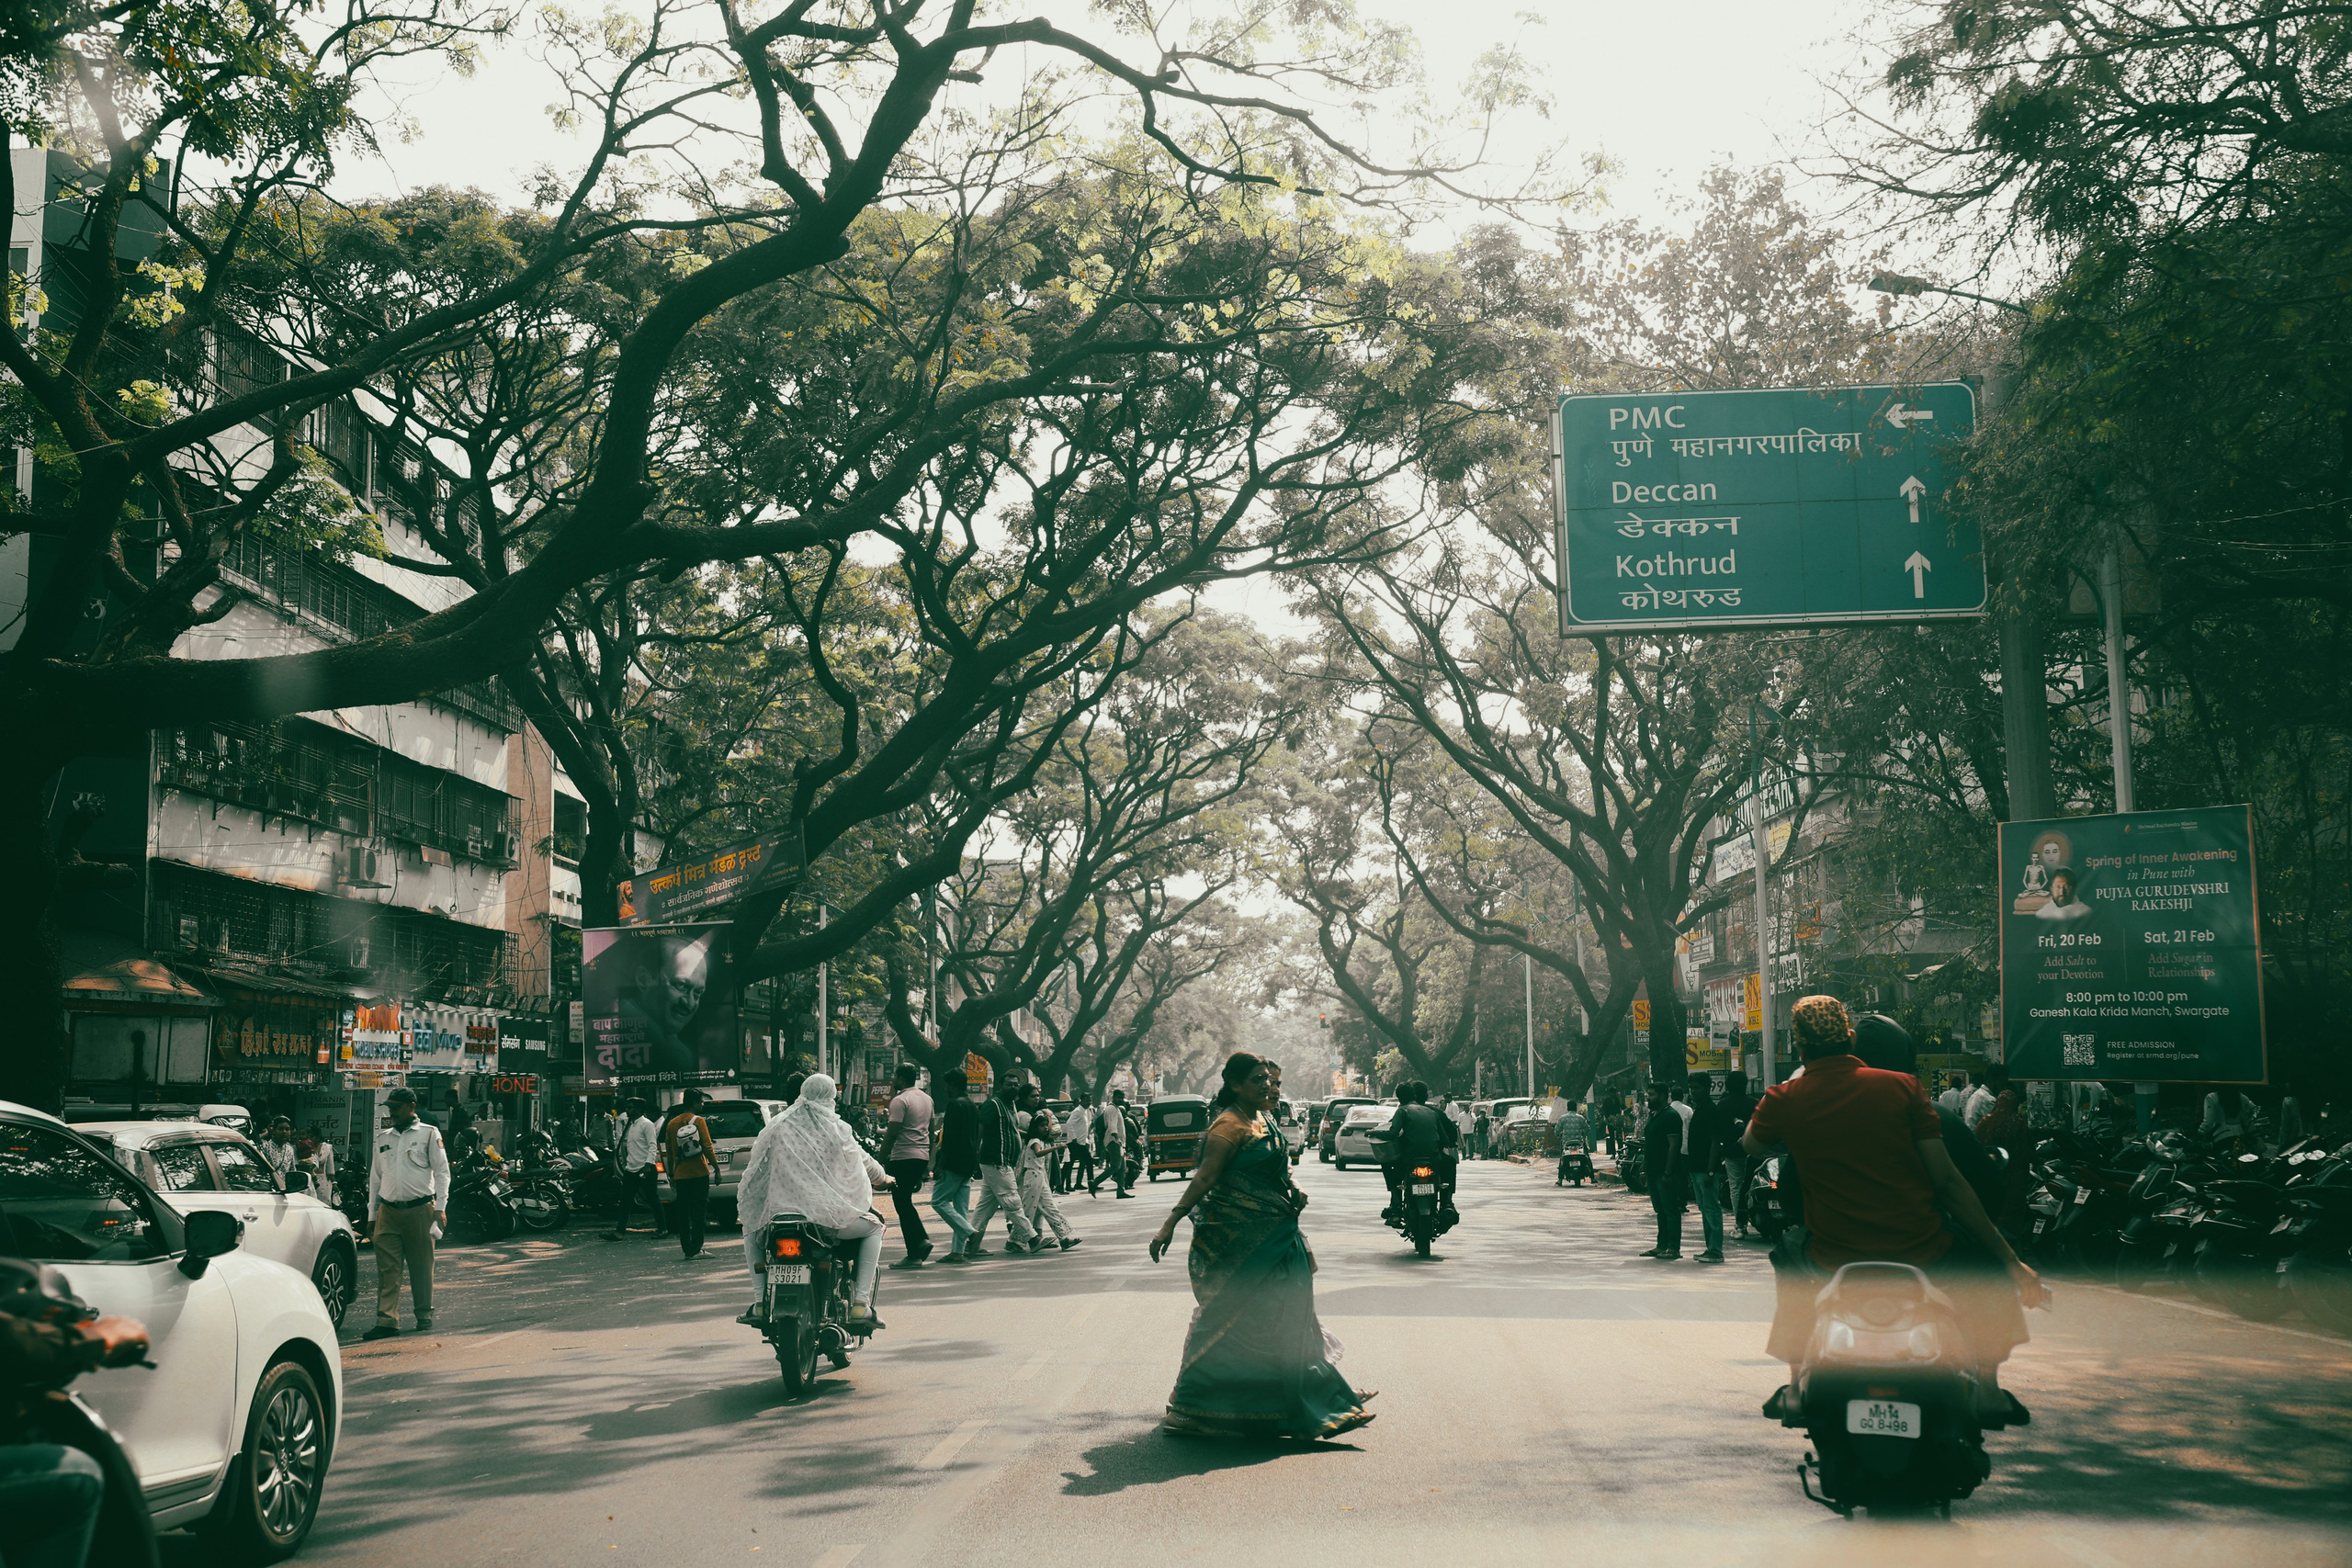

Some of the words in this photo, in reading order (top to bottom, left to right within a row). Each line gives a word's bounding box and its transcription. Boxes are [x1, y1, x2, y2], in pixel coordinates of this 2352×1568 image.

[1610, 405, 1686, 430] PMC
[1611, 433, 1654, 467] पुणे
[1669, 427, 1861, 457] महानगरपालिका
[1611, 480, 1717, 503] Deccan
[1614, 513, 1741, 538] डेक्कन
[1616, 549, 1736, 578] Kothrud
[1619, 583, 1742, 610] कोथरुड
[2086, 856, 2121, 869] Spring
[2125, 853, 2136, 864] of
[2139, 852, 2168, 863] Inner
[2172, 849, 2237, 863] Awakening
[650, 865, 681, 895] उत्कर्ष
[684, 863, 707, 885] मित्र
[708, 853, 736, 874] मंडळ
[739, 845, 762, 870] ट्रस्ट
[2127, 870, 2138, 880] in
[2142, 867, 2168, 880] Pune
[2171, 866, 2195, 878] with
[667, 888, 703, 907] सार्वजनिक
[705, 874, 743, 895] गणेशोत्सव
[2096, 886, 2132, 901] PUJYA
[2135, 882, 2229, 897] GURUDEVSHRI
[2132, 897, 2193, 911] RAKESHJI
[2038, 936, 2057, 948] Fri,
[2060, 934, 2075, 946] 20
[2078, 933, 2101, 945] Feb
[2144, 931, 2167, 945] Sat,
[2174, 931, 2187, 942] 21
[2190, 929, 2215, 942] Feb
[2044, 956, 2064, 966] Add
[2065, 955, 2085, 966] Salt
[2086, 956, 2097, 965] to
[2148, 953, 2169, 964] Add
[2171, 953, 2201, 966] Sugar
[2203, 953, 2213, 963] in
[2038, 971, 2058, 984] your
[2061, 969, 2104, 979] Devotion
[2148, 966, 2215, 980] Relationships
[2066, 992, 2092, 1002] 8:00
[2095, 995, 2115, 1006] pm
[2118, 992, 2131, 1002] to
[2133, 991, 2164, 1001] 10:00
[2167, 993, 2188, 1004] pm
[2030, 1008, 2070, 1018] Ganesh
[2074, 1007, 2097, 1017] Kala
[2099, 1007, 2128, 1017] Krida
[2132, 1007, 2172, 1018] Manch,
[2175, 1007, 2229, 1019] Swargate
[593, 1019, 612, 1030] बाप
[435, 1028, 462, 1050] vivo
[525, 1039, 546, 1051] SAMSUNG
[2128, 1041, 2175, 1049] ADMISSION
[595, 1043, 651, 1069] दादा
[2107, 1052, 2135, 1060] Register
[2146, 1052, 2199, 1060] srmd.org/pune
[659, 1071, 677, 1082] शिंदे
[871, 1086, 891, 1095] PEPERO
[775, 1266, 803, 1274] MH09F
[775, 1275, 801, 1283] S3021
